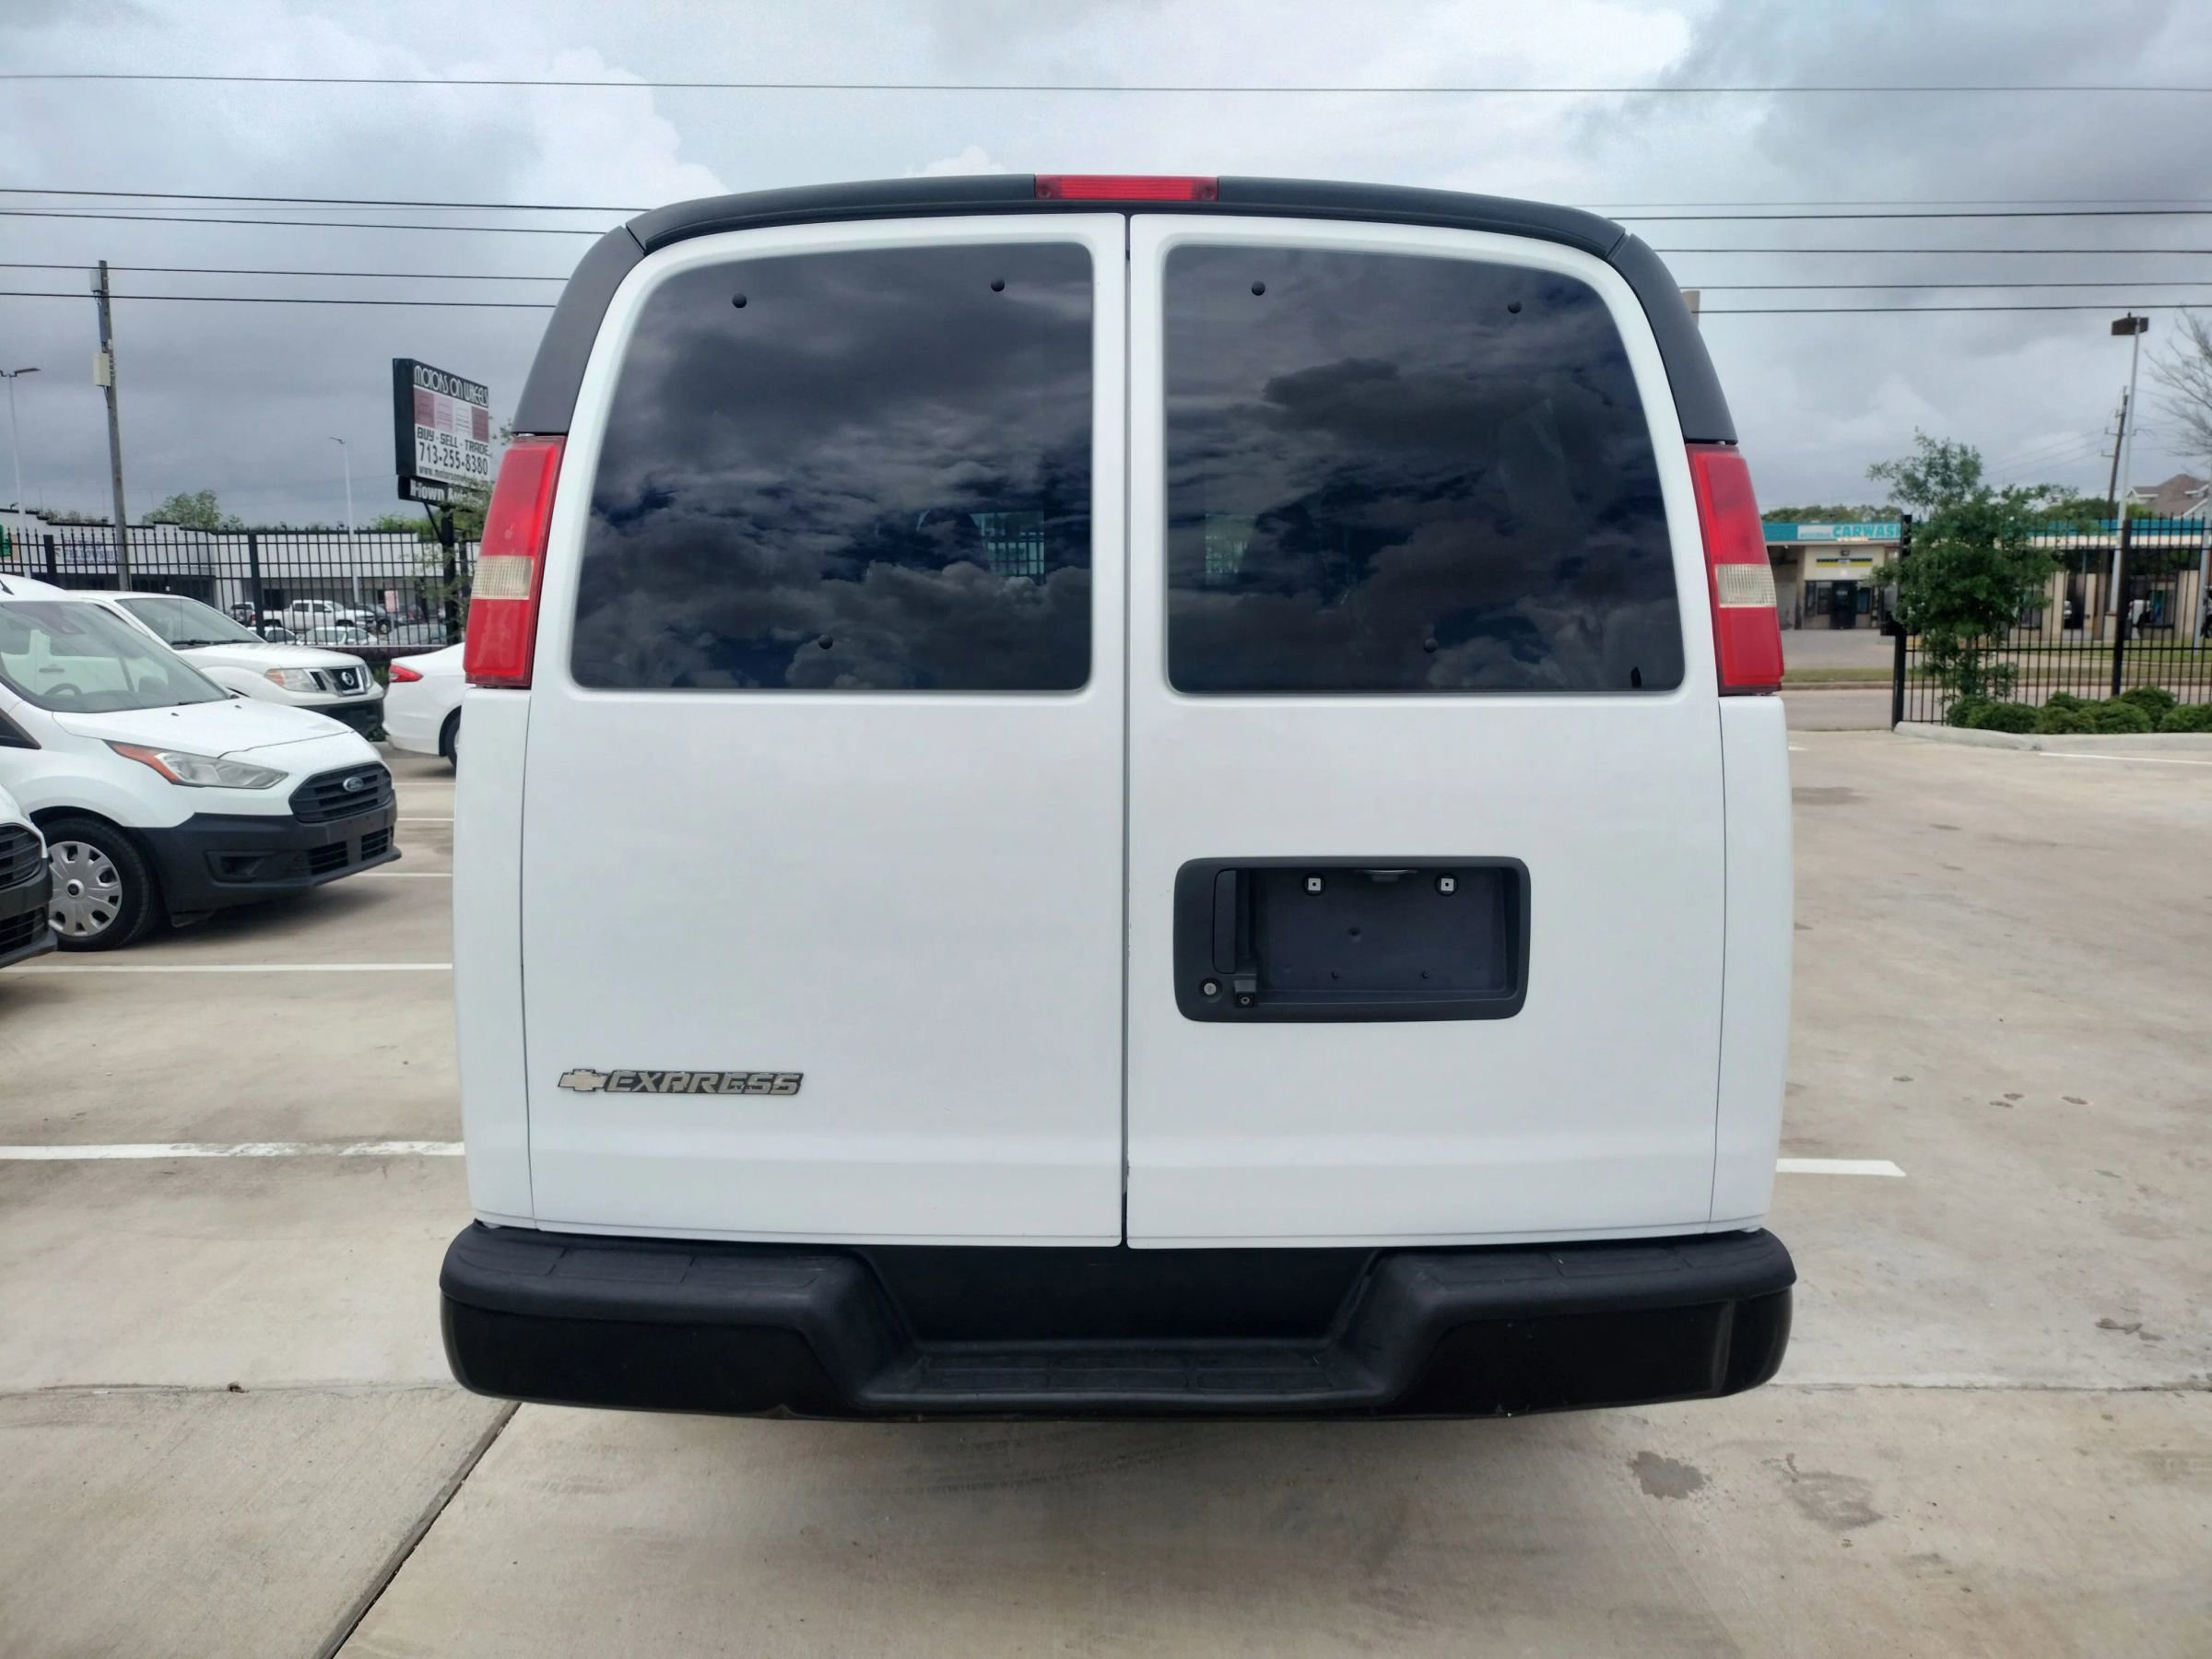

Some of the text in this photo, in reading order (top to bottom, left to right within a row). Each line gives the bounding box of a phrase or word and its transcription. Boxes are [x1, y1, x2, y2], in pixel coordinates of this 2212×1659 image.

[414, 365, 449, 394] MOTORS
[450, 377, 464, 399] ON
[417, 426, 435, 441] BUY
[440, 433, 458, 449] SELL
[419, 441, 488, 476] 713-255-8380
[65, 548, 118, 560] FELLOWSHI
[606, 1070, 803, 1095] EXPRESS
